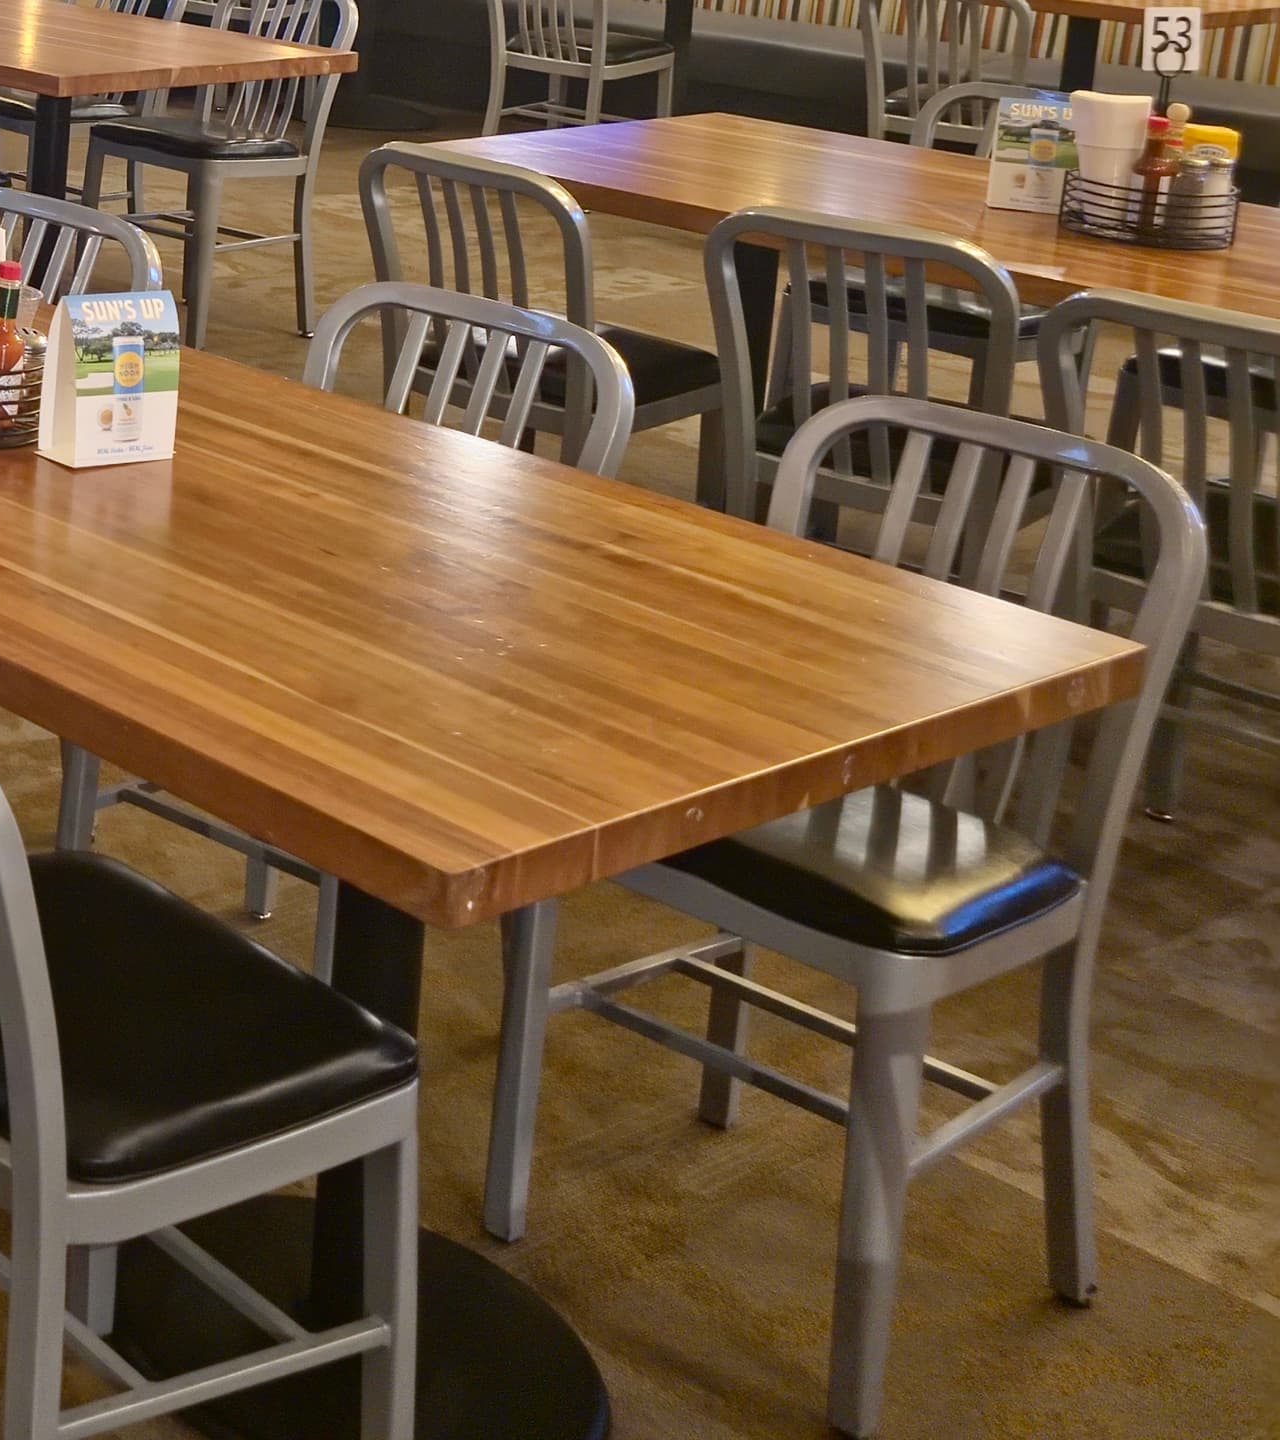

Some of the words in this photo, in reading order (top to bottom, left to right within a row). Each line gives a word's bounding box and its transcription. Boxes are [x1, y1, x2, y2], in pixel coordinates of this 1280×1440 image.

[1151, 16, 1192, 53] 53
[1009, 103, 1057, 120] SUN'S
[1062, 107, 1073, 120] U
[81, 299, 137, 323] SUN'S
[140, 298, 165, 320] UP
